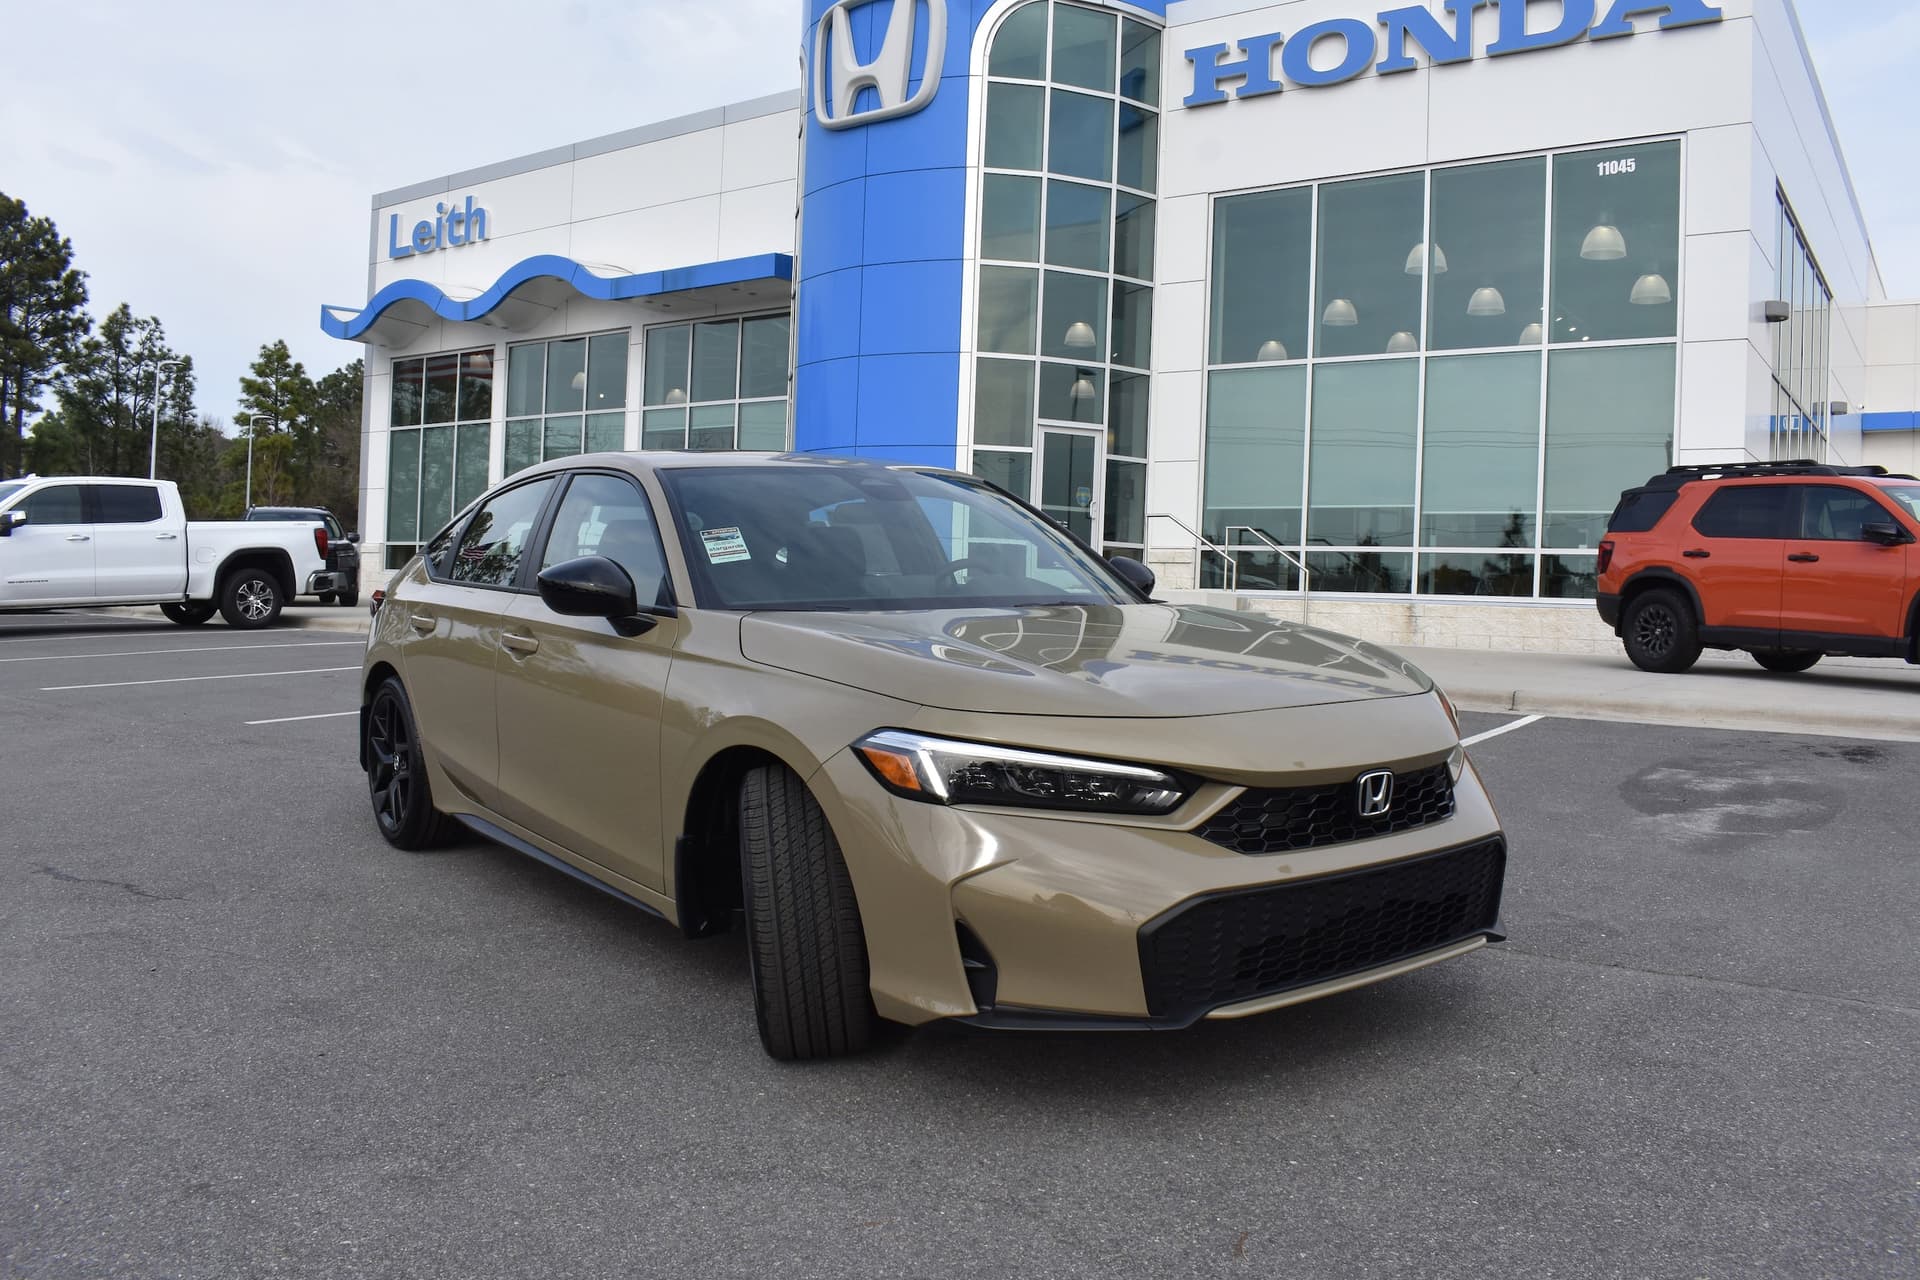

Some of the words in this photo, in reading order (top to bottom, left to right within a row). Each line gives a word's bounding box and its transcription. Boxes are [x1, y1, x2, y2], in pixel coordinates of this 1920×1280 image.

[1183, 0, 1722, 108] HONDA
[1597, 158, 1636, 176] 11045
[389, 195, 487, 259] Leith
